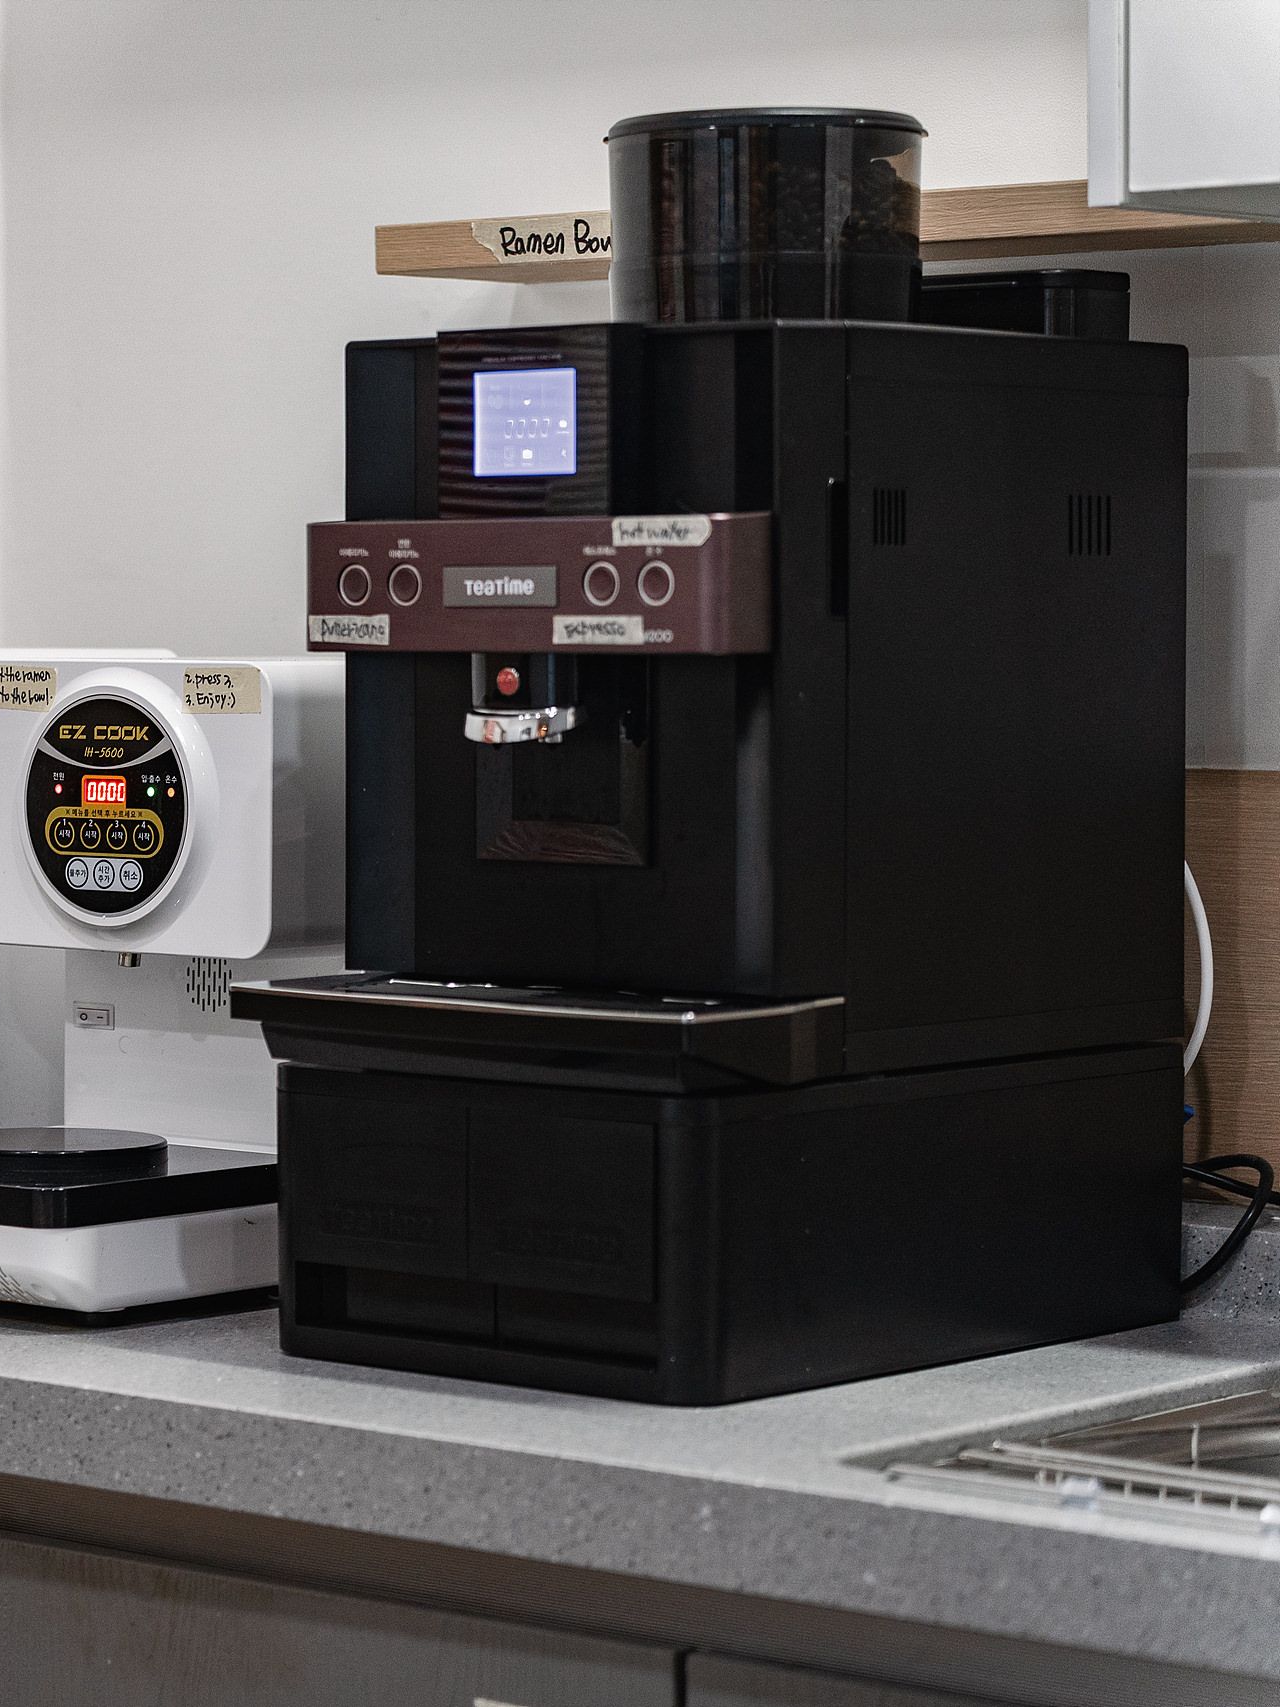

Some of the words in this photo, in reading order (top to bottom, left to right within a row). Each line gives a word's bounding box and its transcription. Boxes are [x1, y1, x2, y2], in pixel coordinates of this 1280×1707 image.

[500, 226, 565, 257] Ramen
[464, 575, 535, 597] TeaTime
[4, 666, 21, 682] the
[22, 670, 51, 683] ramen
[195, 673, 222, 689] press
[11, 687, 27, 705] the
[59, 724, 86, 740] EZ
[93, 725, 149, 741] COOK
[84, 747, 124, 758] IH-5600
[87, 781, 125, 802] 0000
[91, 809, 103, 817] 선택
[112, 809, 136, 818] 누르세요
[88, 819, 93, 827] 2
[115, 820, 120, 828] 3
[141, 821, 146, 829] 4
[58, 829, 71, 838] 시작
[84, 830, 97, 839] 시작
[111, 832, 124, 840] 시작
[138, 832, 150, 841] 시작
[98, 866, 110, 874] 시간
[98, 875, 110, 883] 추가
[123, 870, 138, 881] 취소
